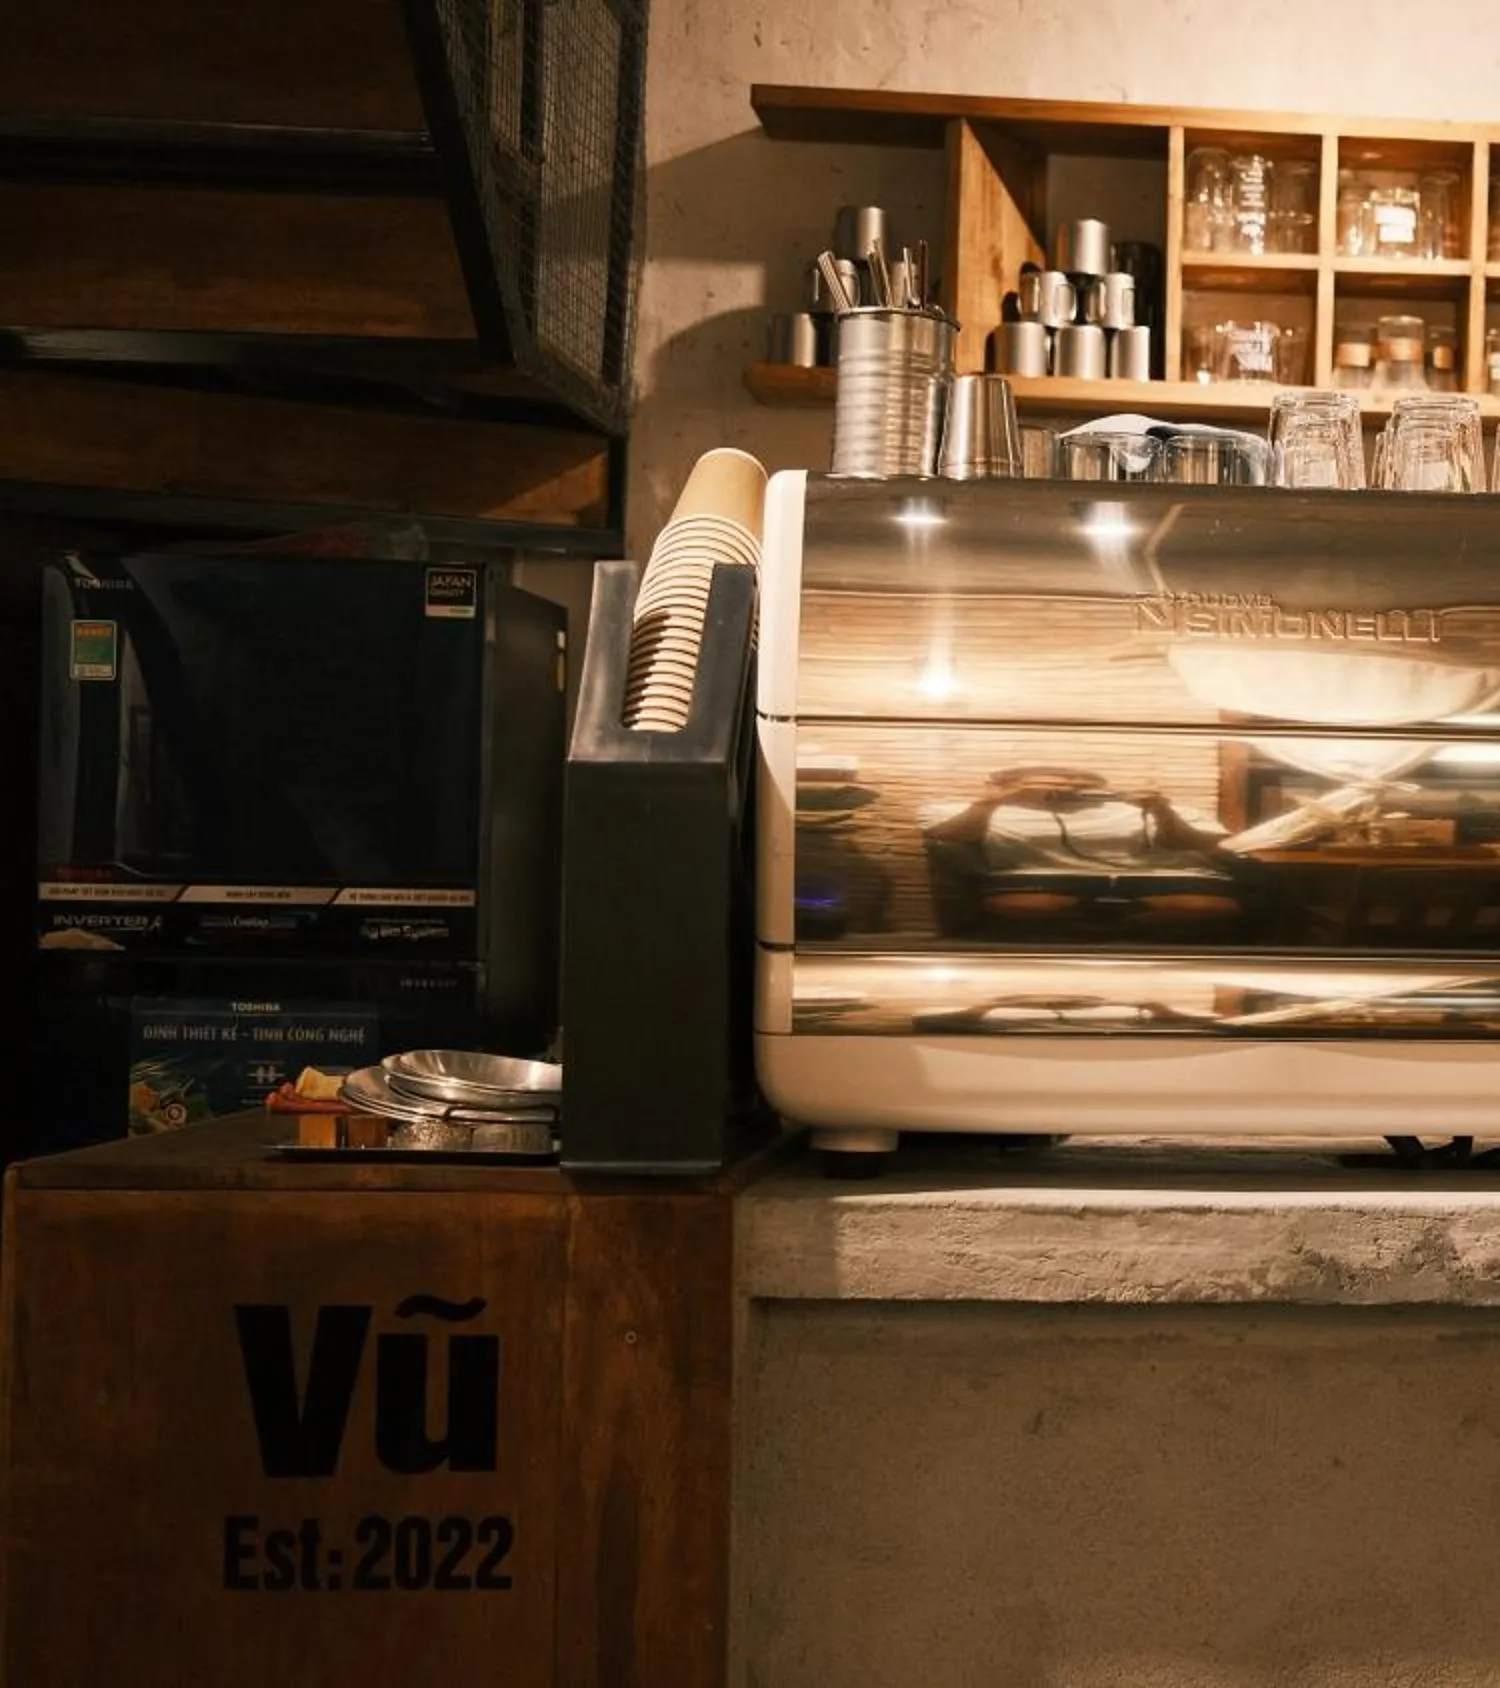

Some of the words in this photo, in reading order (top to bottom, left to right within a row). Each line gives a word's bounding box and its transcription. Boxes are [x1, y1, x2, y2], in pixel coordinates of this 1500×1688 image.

[231, 1001, 281, 1012] TOSHIBA
[233, 1295, 499, 1477] Vũ
[224, 1516, 513, 1591] Est:2022
